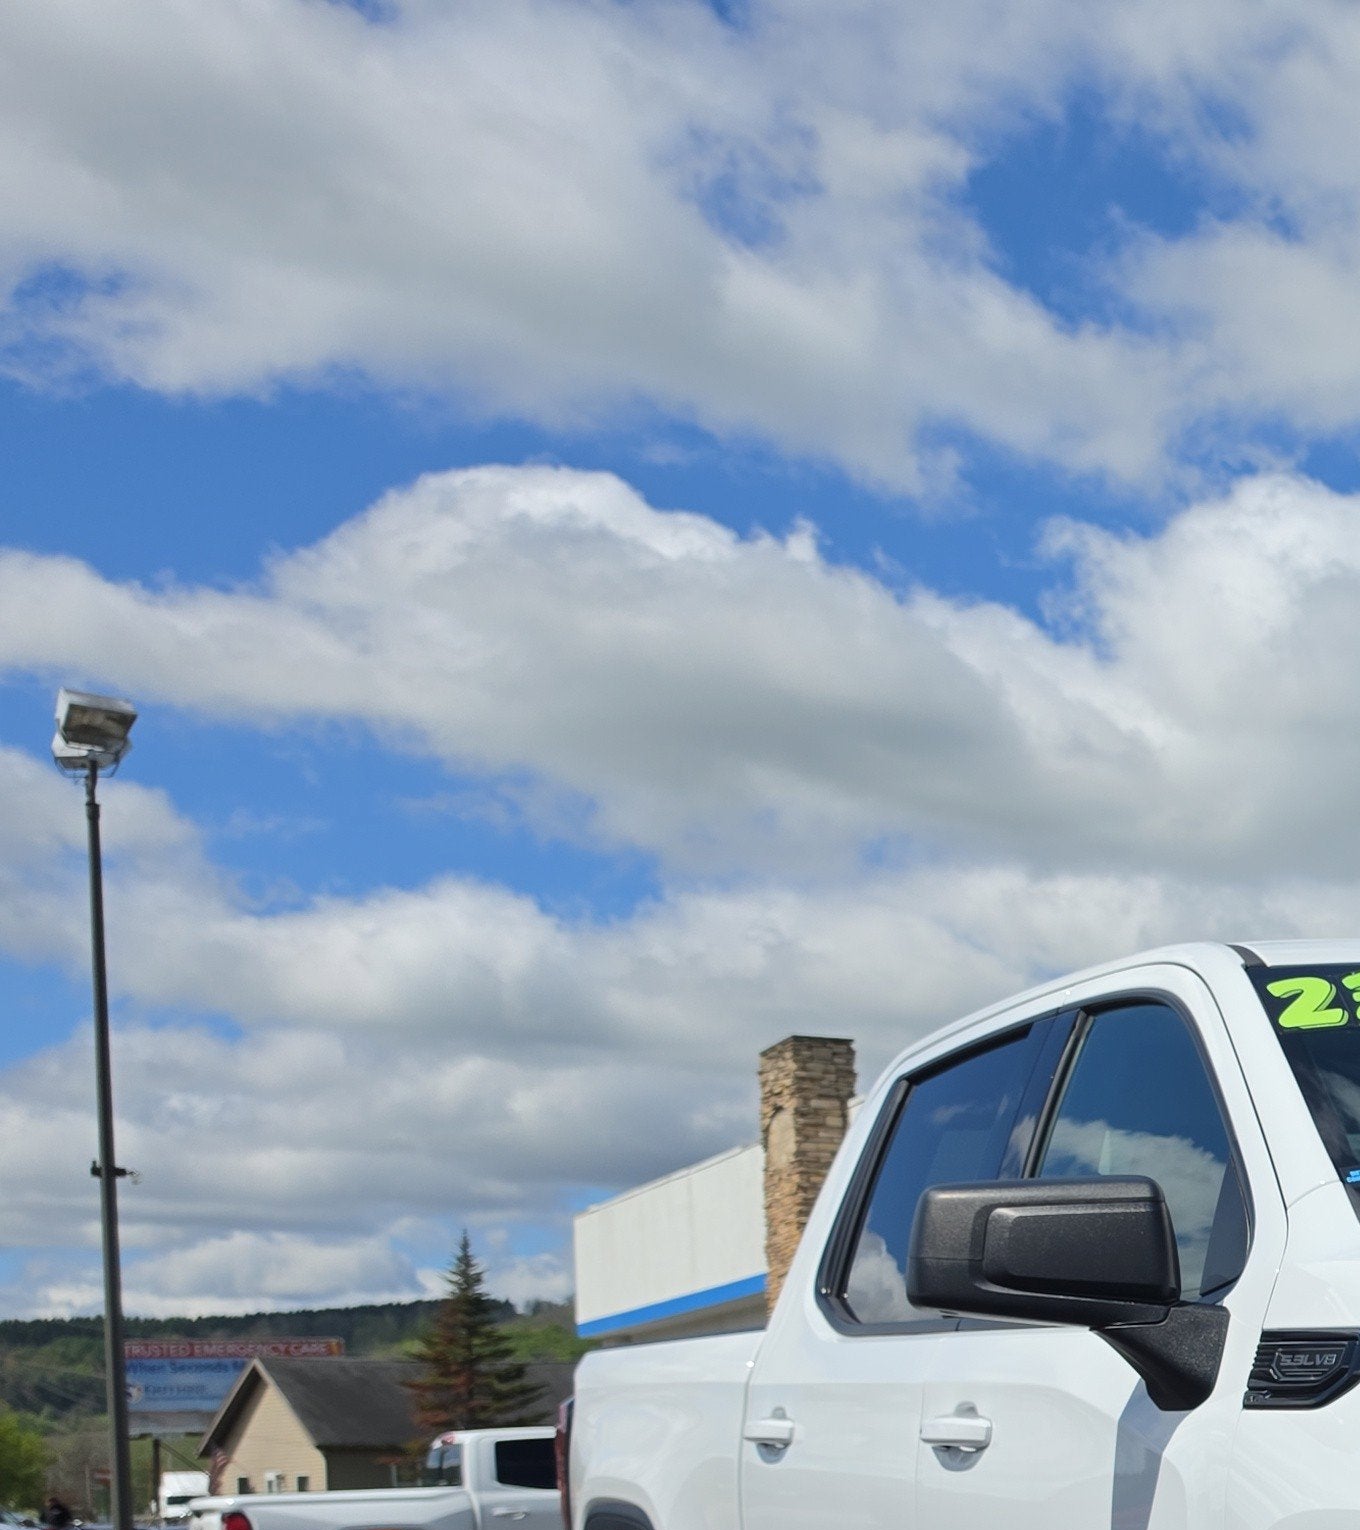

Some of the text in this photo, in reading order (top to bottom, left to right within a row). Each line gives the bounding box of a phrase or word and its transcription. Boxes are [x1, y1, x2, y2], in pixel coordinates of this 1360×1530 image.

[124, 1342, 329, 1358] TRUSTED EMERGENCY CARE
